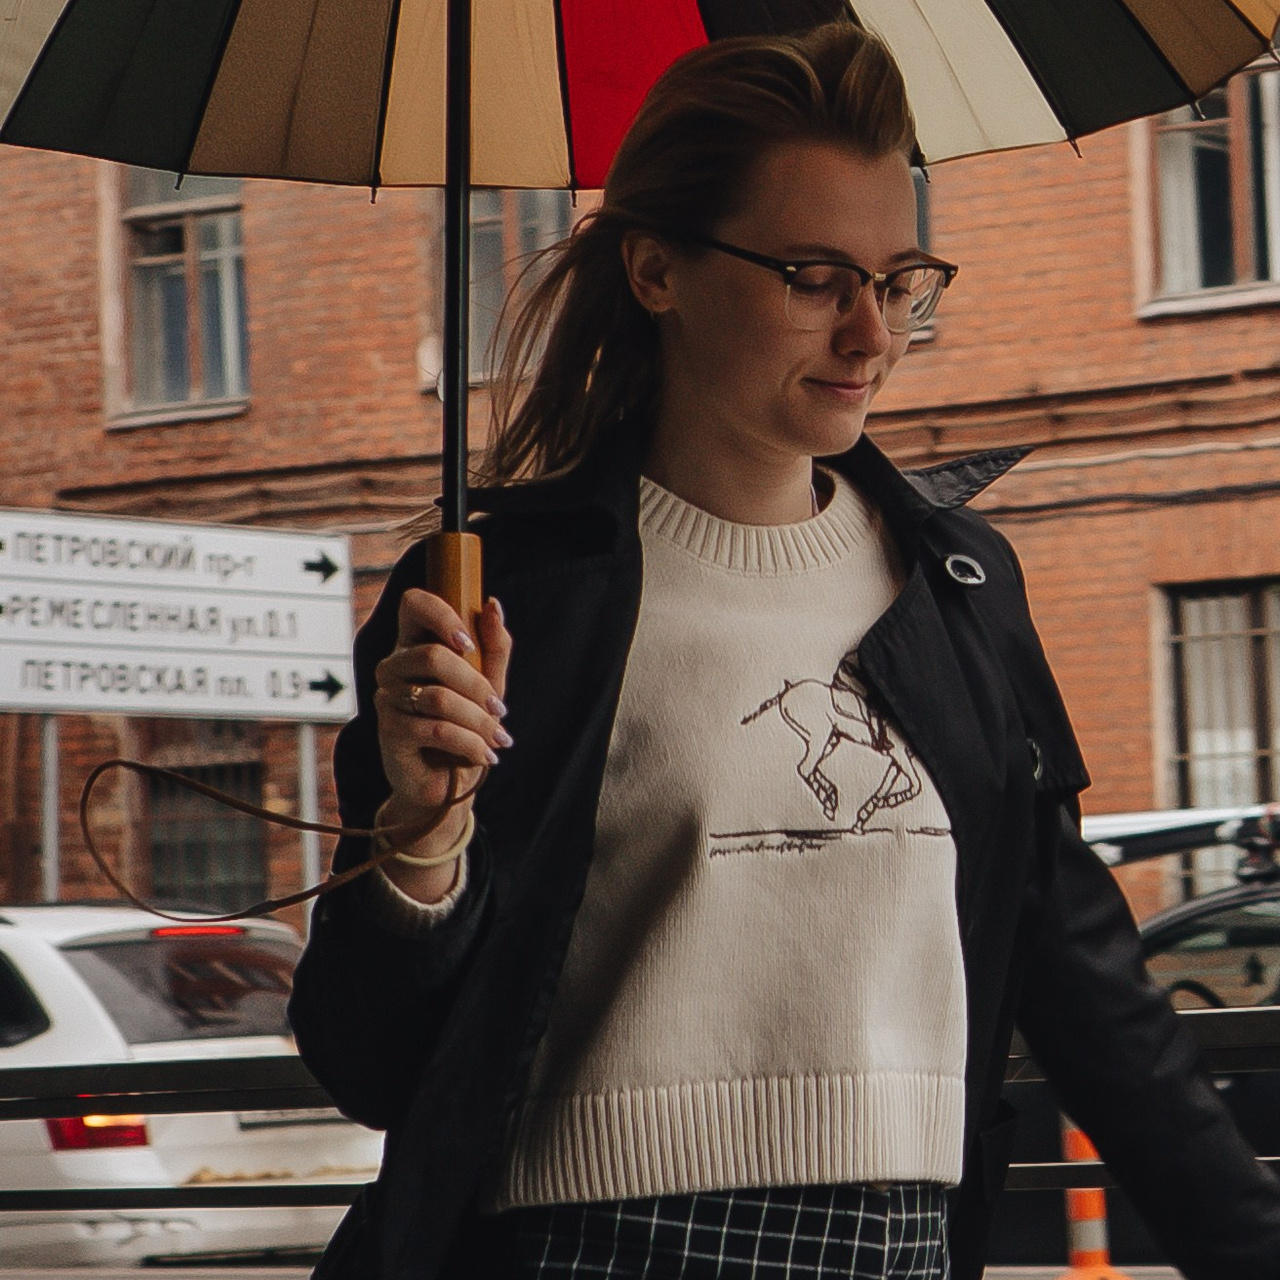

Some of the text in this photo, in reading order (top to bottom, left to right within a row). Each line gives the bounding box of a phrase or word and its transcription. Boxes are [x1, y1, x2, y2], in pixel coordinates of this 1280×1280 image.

[14, 531, 197, 569] ПЕТРОВСКИЙ
[10, 595, 221, 633] РЕМЕСЛЕННАЯ
[21, 659, 206, 694] ПЕТРОВСКАЯ
